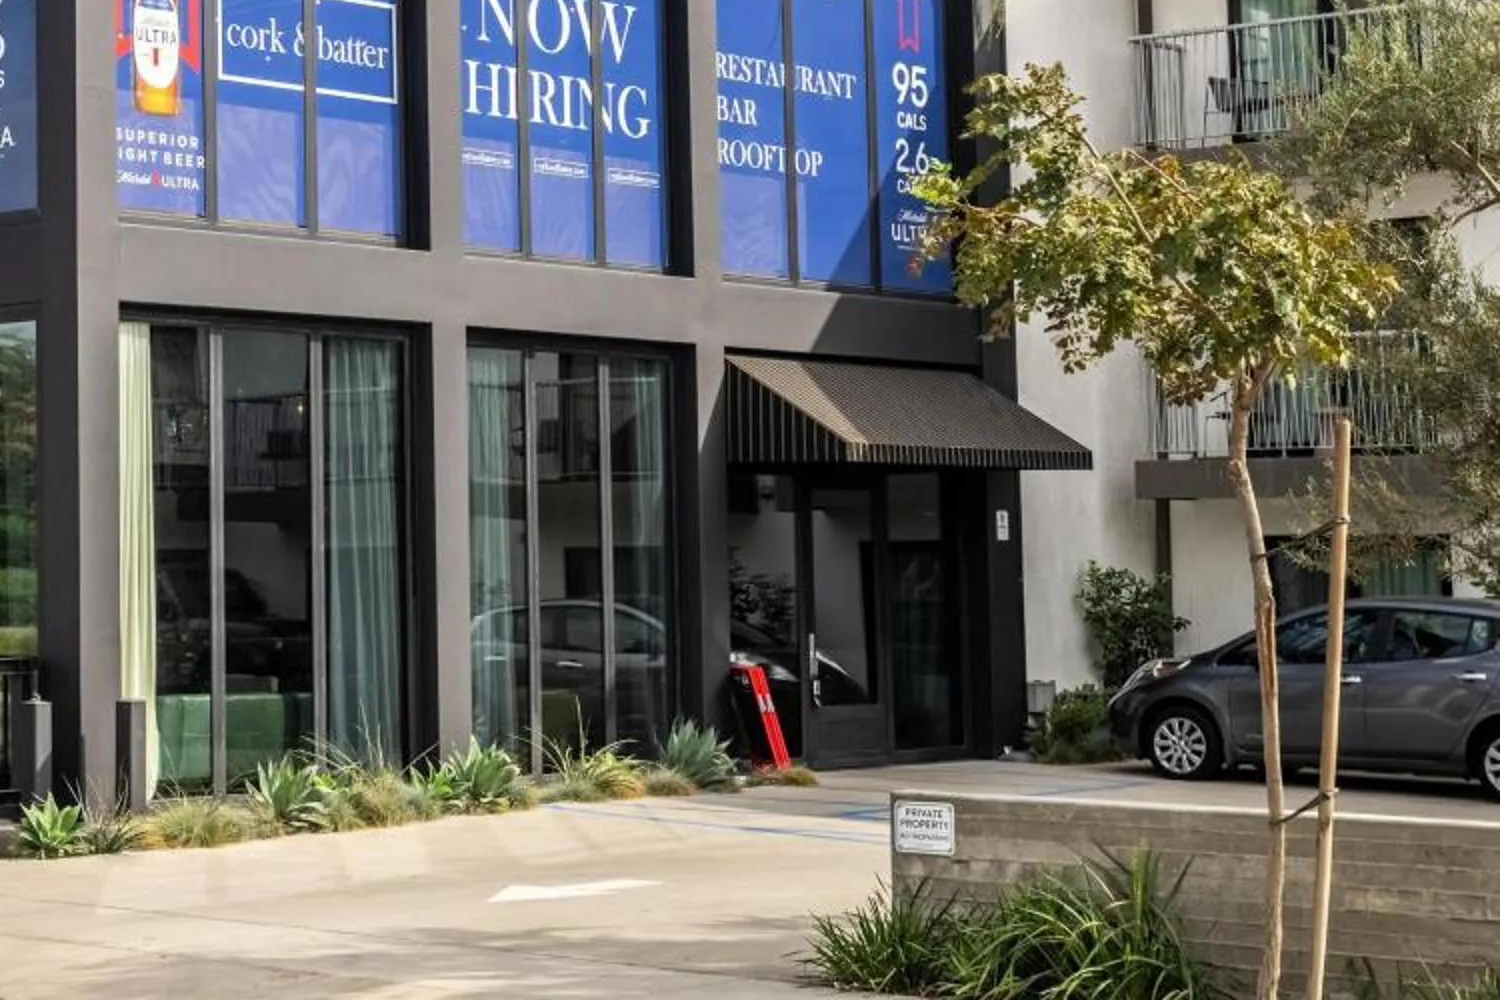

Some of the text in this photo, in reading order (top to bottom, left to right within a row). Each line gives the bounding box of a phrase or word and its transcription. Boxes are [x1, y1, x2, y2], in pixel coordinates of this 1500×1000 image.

[136, 26, 177, 44] ULTRA
[227, 17, 287, 54] cork
[317, 24, 389, 69] batter
[715, 51, 857, 99] RESTAURANT
[892, 61, 929, 108] 95
[463, 59, 652, 139] HIRING
[716, 95, 757, 126] BAR
[897, 111, 927, 131] CALS
[115, 127, 199, 149] SUPERIOR
[117, 146, 205, 169] IGHT BEER
[717, 137, 823, 177] ROOFTOP
[895, 137, 929, 174] 2.6
[161, 175, 199, 190] ULTRA
[891, 223, 927, 242] ULT
[900, 818, 948, 830] PROPERTY
[905, 807, 943, 818] PRIVATE
